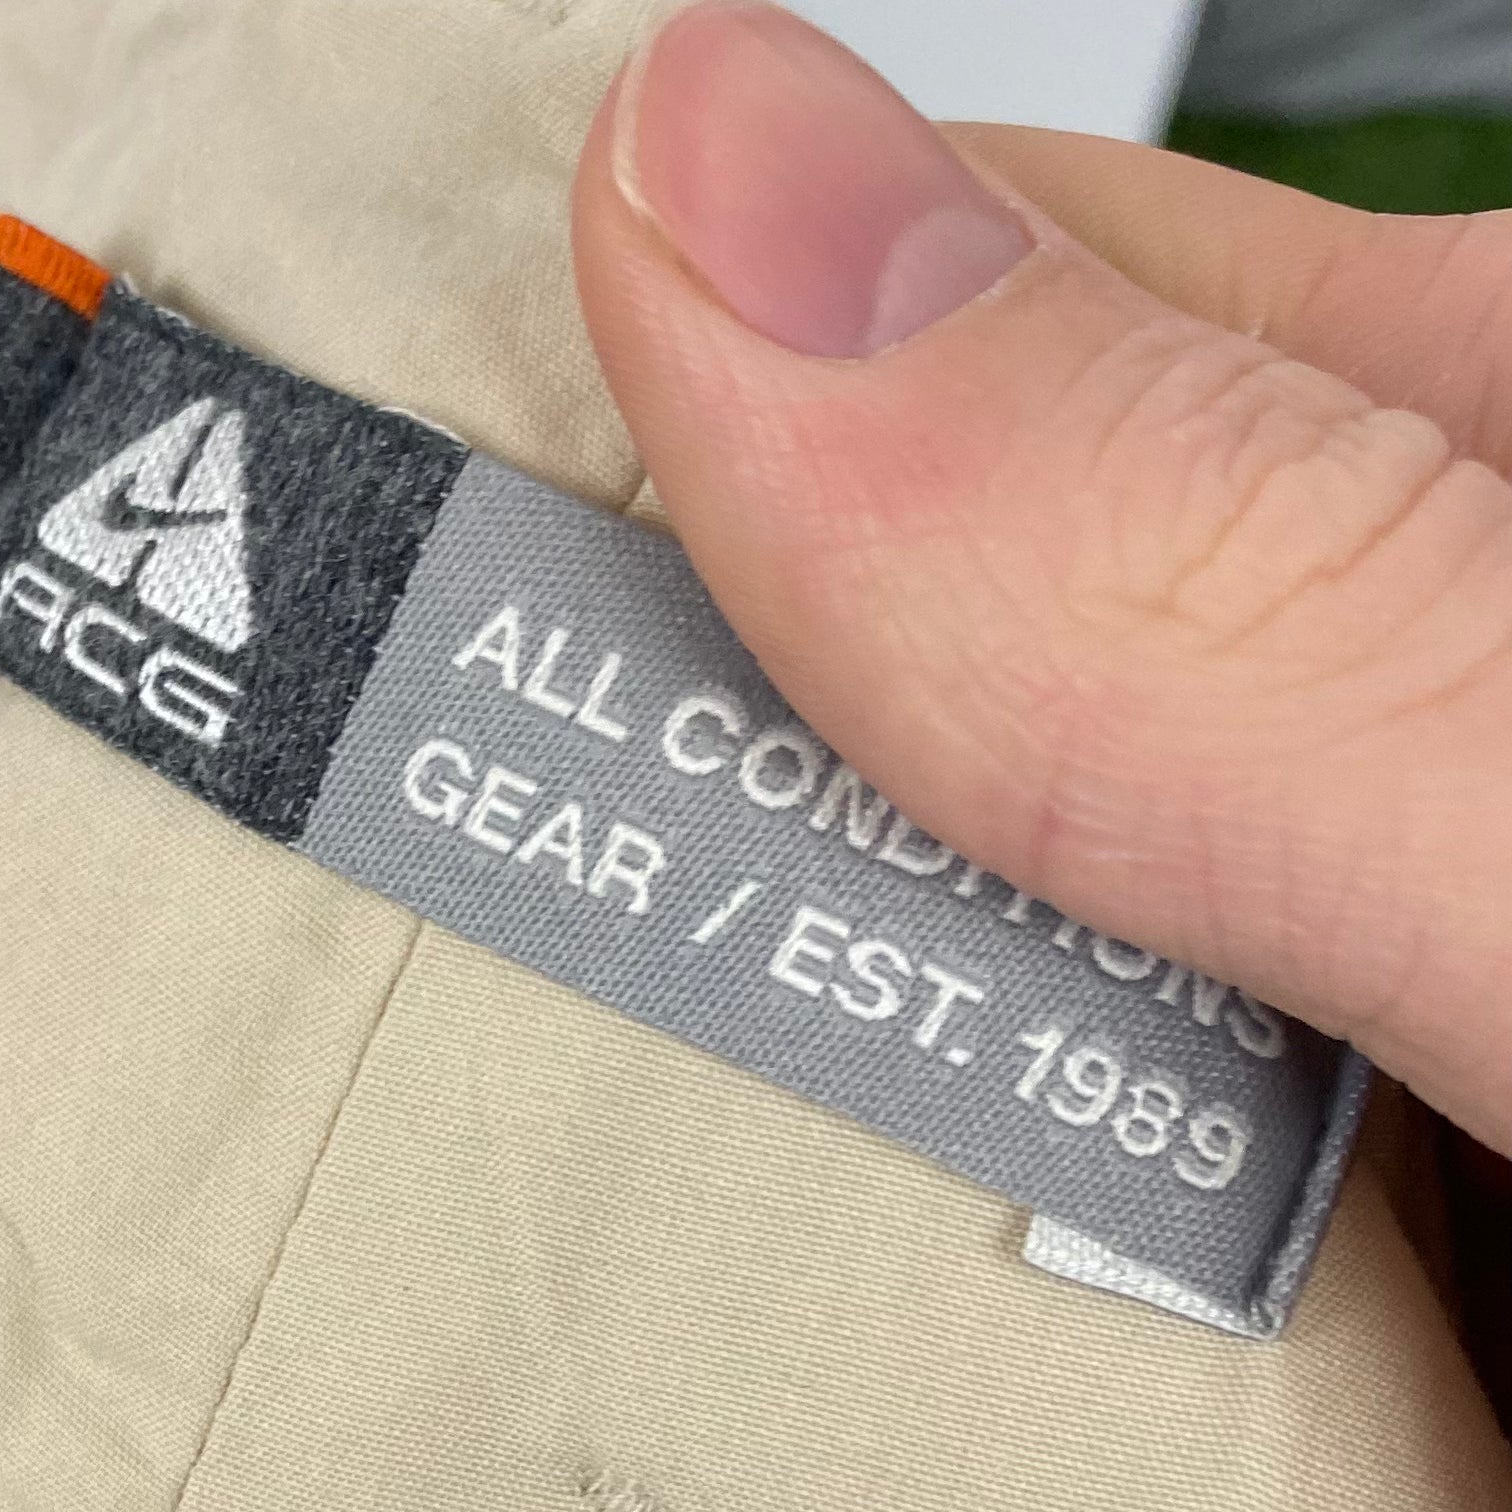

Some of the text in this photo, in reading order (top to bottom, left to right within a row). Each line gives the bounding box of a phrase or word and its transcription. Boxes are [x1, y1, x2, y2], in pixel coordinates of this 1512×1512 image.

[451, 606, 629, 743] ALL
[401, 738, 1251, 1191] GEAR / EST. 1989
